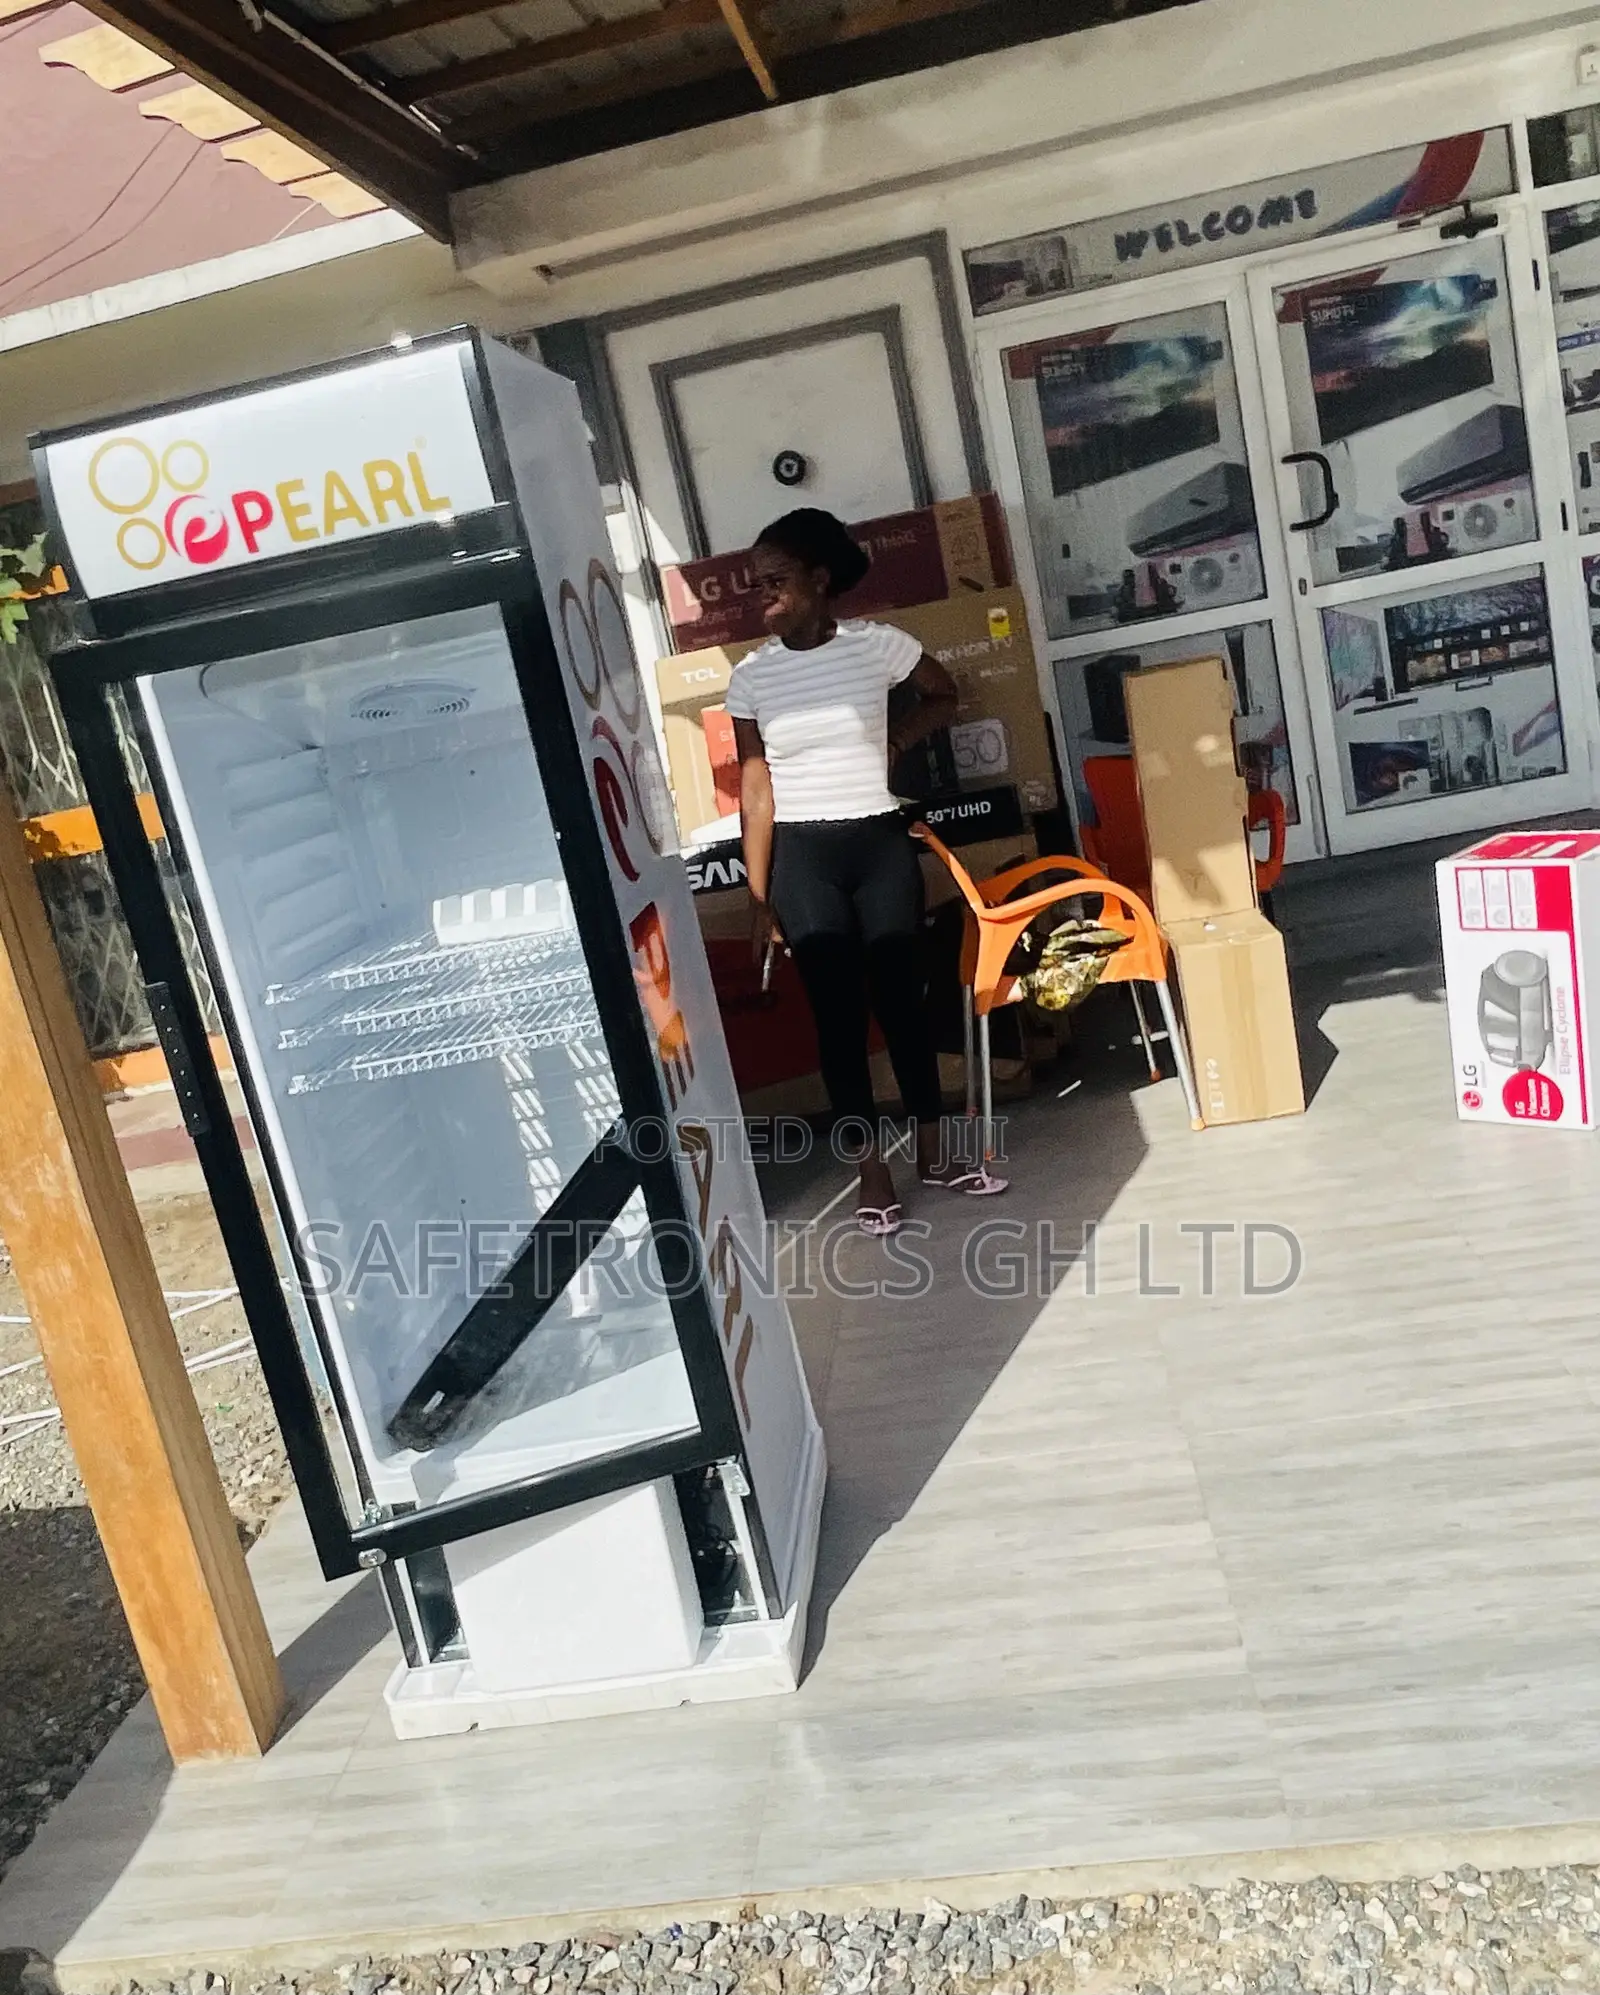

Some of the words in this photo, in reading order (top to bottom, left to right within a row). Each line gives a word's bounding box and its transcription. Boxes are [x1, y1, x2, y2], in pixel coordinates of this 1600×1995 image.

[231, 451, 452, 554] PEARL
[681, 667, 721, 684] TCL
[1462, 1064, 1479, 1087] LG
